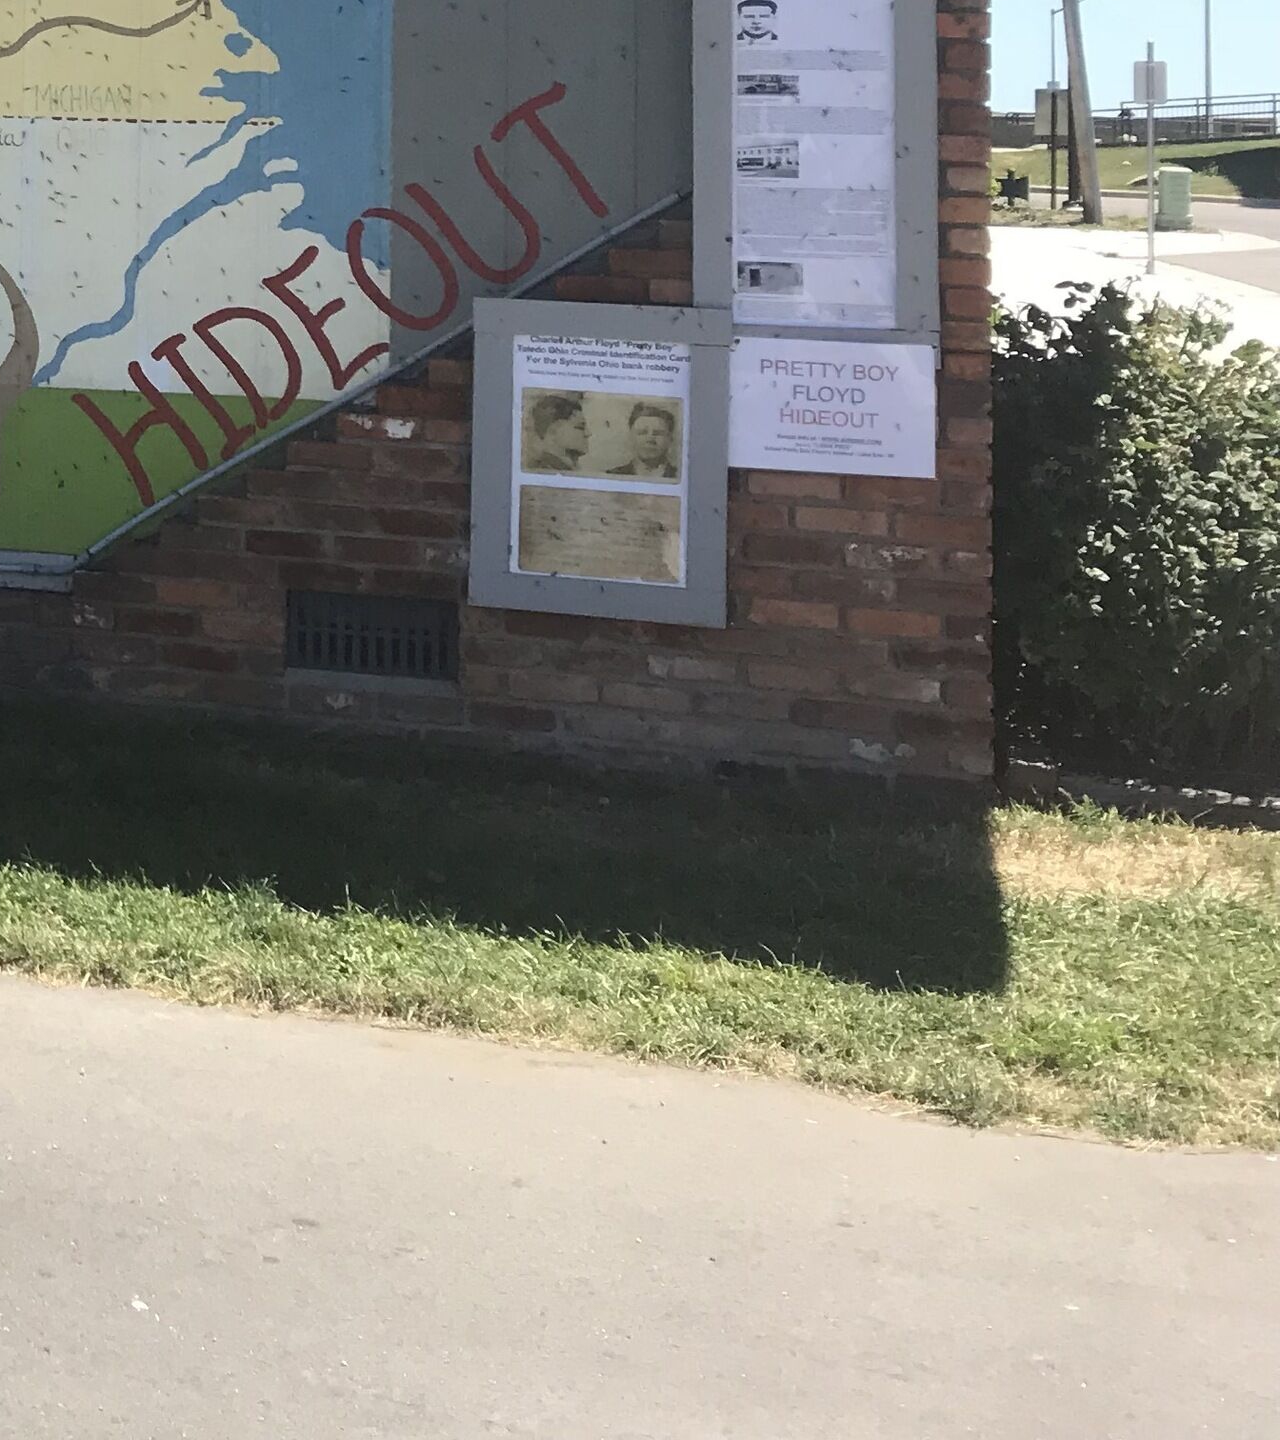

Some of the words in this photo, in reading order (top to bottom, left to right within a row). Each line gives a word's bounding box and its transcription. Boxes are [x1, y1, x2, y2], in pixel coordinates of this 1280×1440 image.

[35, 83, 133, 112] MICHIGAN
[73, 82, 609, 506] HIDEOUT
[645, 362, 680, 373] robbery
[760, 359, 847, 379] PRETTY
[853, 364, 899, 382] BOY
[792, 384, 866, 404] FLOYD
[779, 408, 879, 429] HIDEOUT
